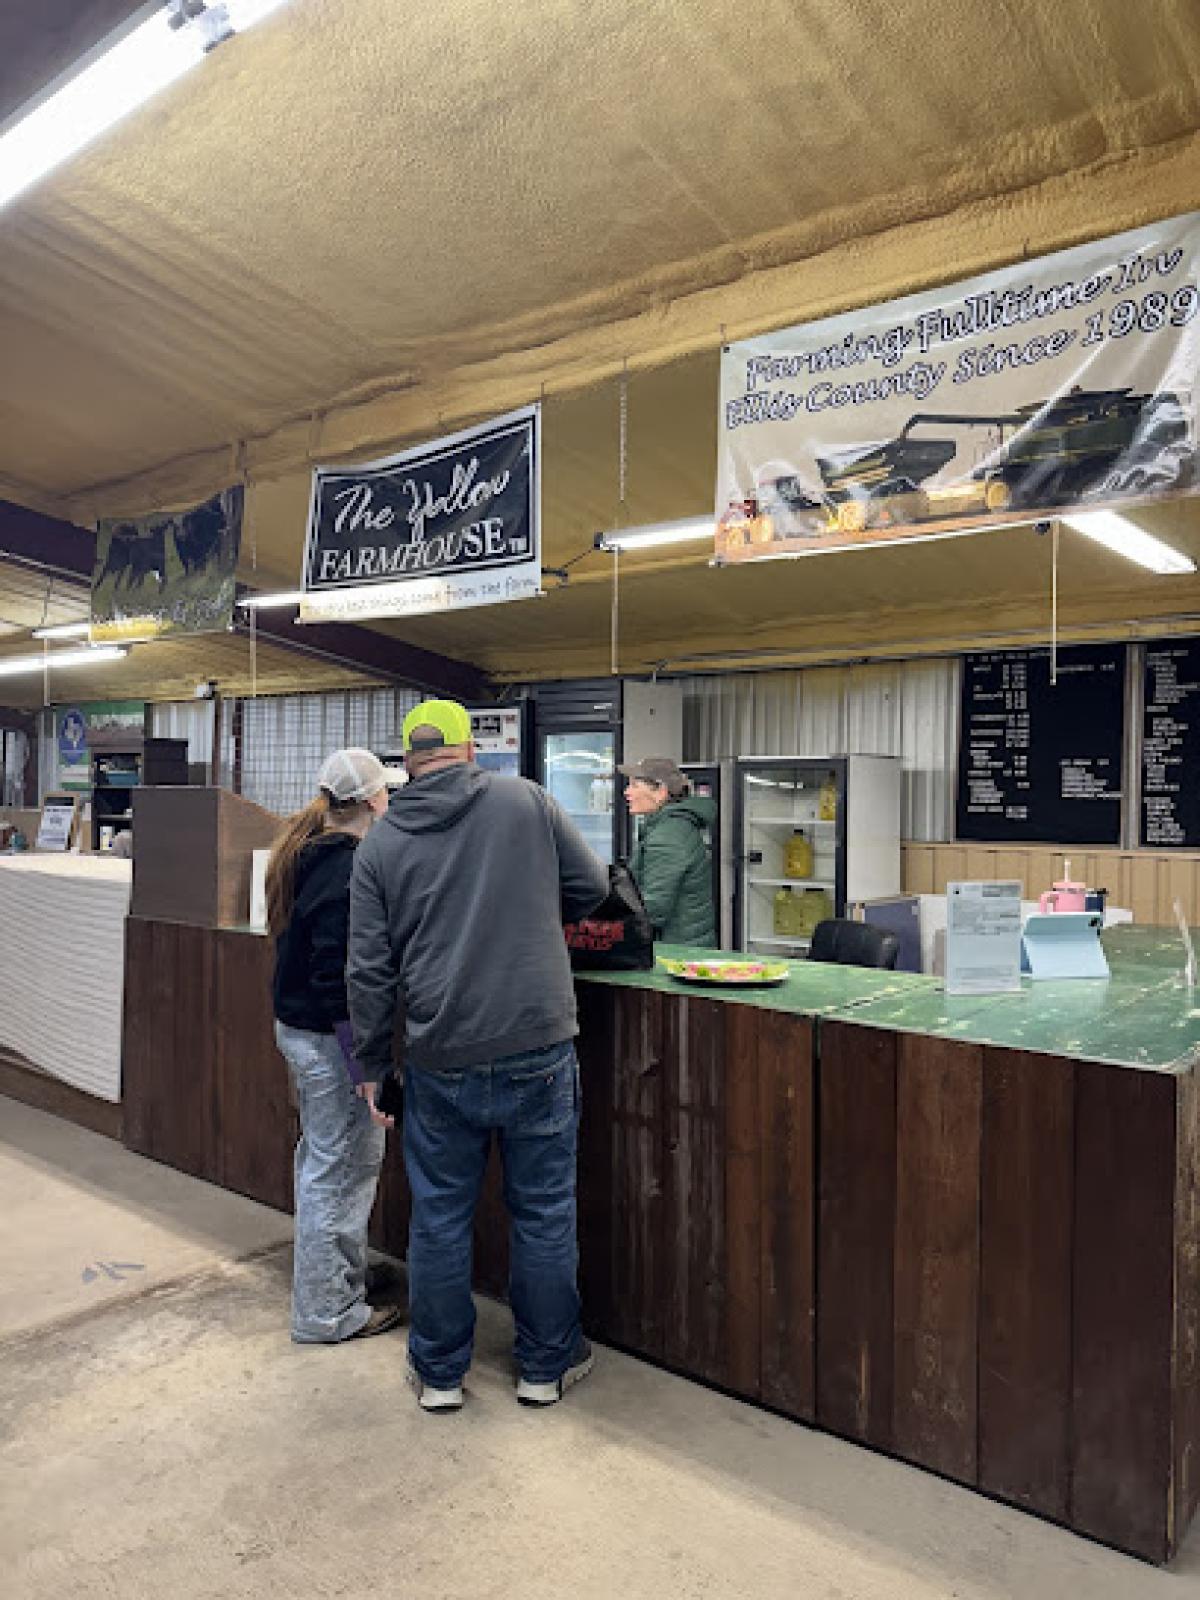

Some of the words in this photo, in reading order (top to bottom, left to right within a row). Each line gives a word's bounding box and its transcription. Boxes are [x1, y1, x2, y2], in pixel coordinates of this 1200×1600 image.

[726, 390, 803, 430] Ellis
[806, 361, 948, 413] County
[952, 329, 1078, 384] Since
[1080, 284, 1199, 348] 1989
[746, 331, 915, 392] Farming
[915, 283, 1113, 354] Fulltime
[1111, 247, 1184, 295] In
[319, 516, 507, 581] FARMHOUSE
[333, 482, 396, 534] The
[402, 457, 511, 544] Yellow
